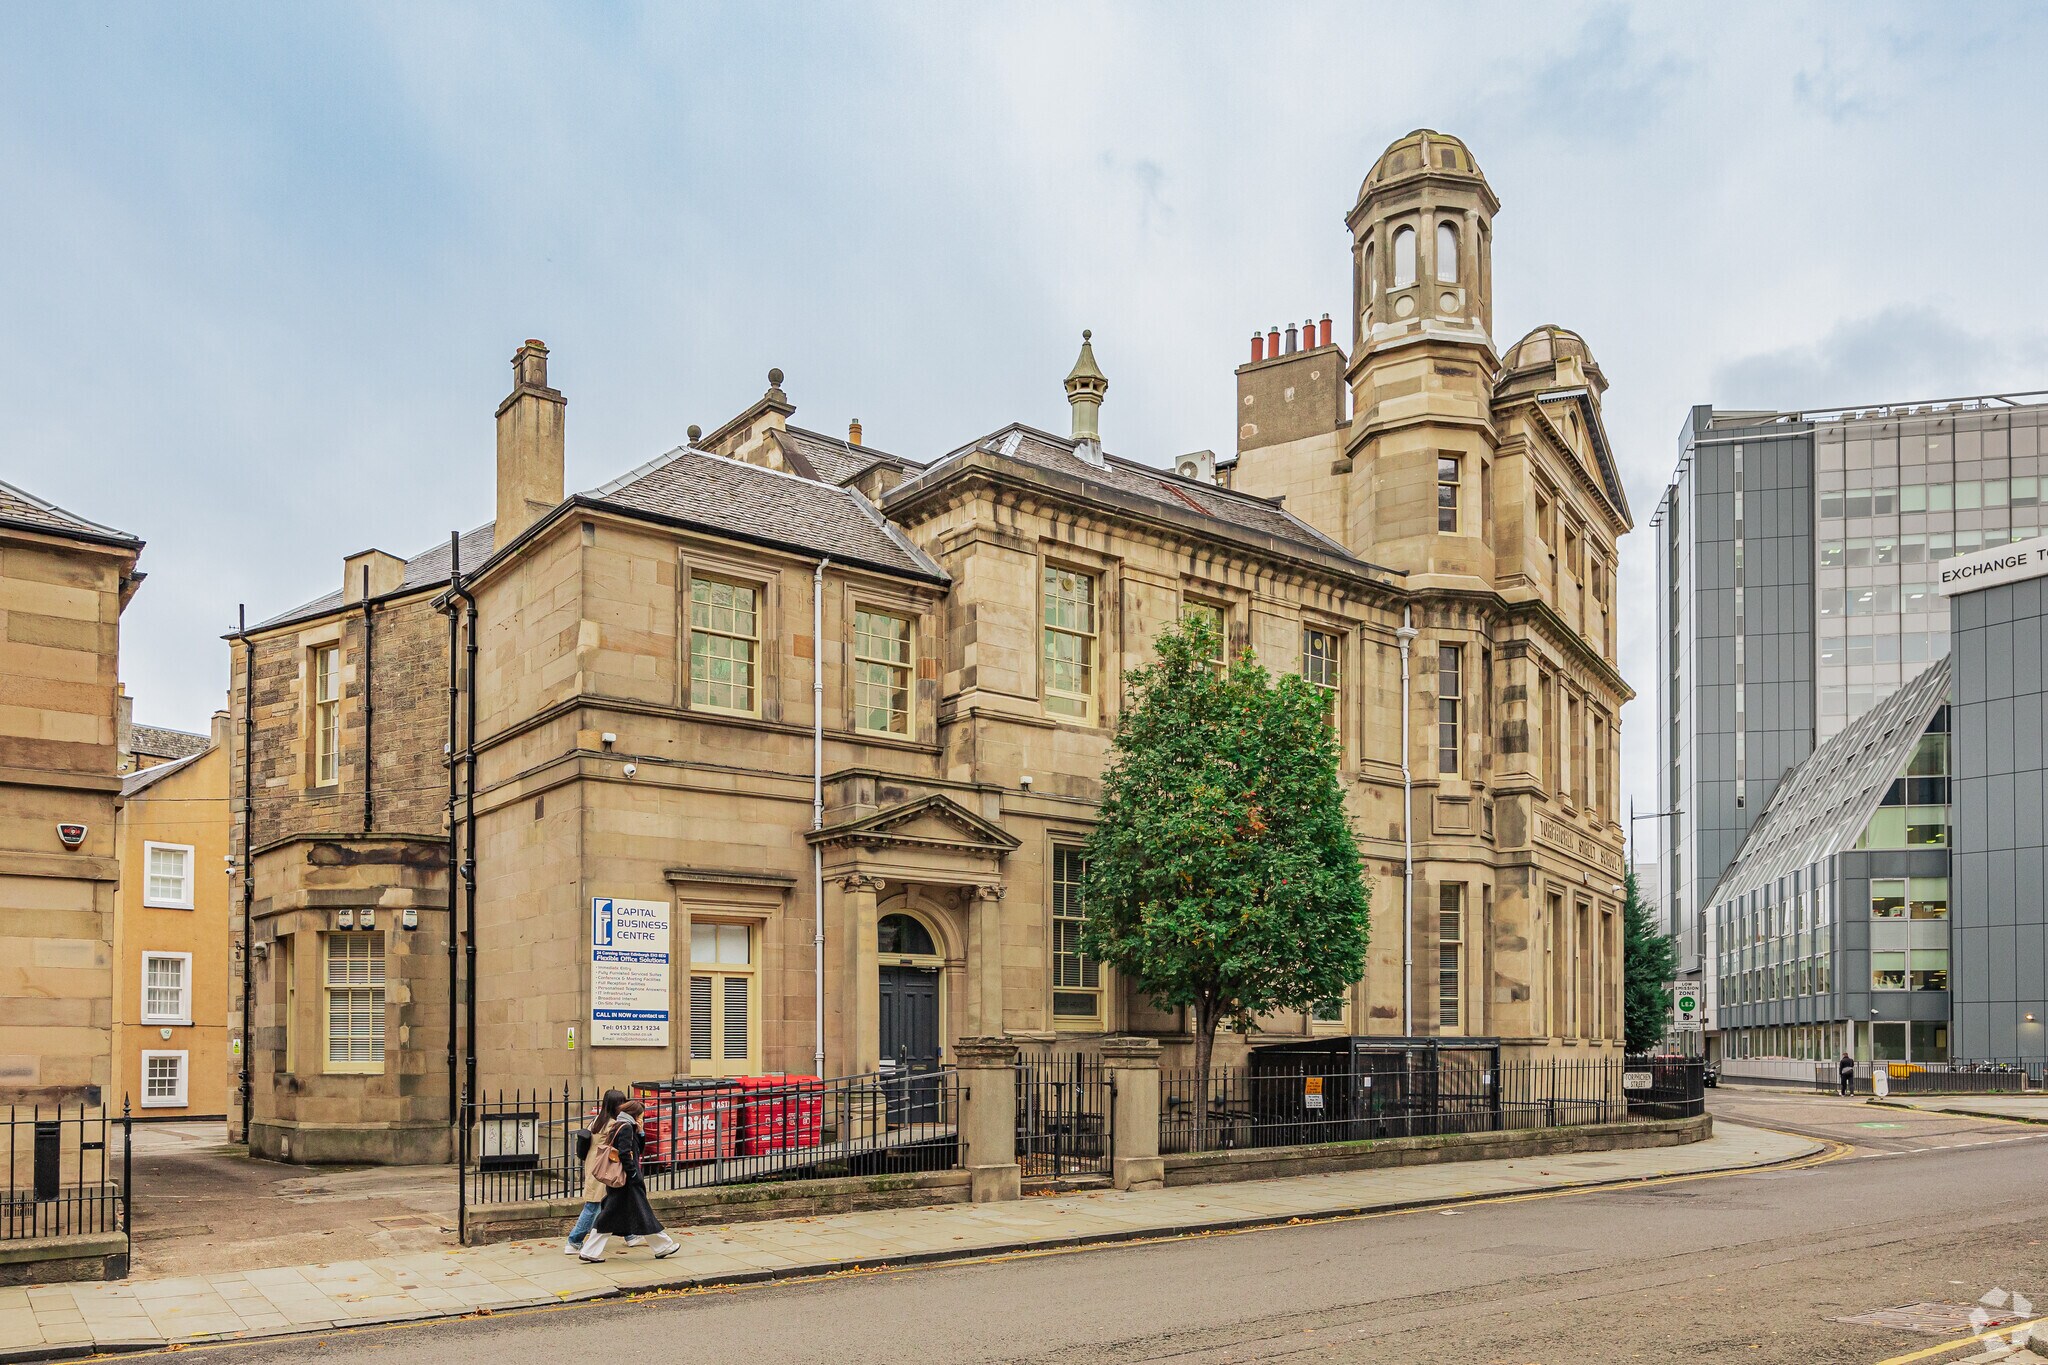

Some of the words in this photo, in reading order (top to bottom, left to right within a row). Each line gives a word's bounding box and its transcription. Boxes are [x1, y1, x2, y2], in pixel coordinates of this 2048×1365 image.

[1942, 553, 2027, 583] EXCHANGE
[2037, 548, 2048, 560] T
[1540, 820, 1574, 849] TORPHICHEN
[1578, 839, 1596, 860] STREET
[1600, 849, 1618, 871] SCHOOL
[617, 907, 656, 917] CAPITAL
[617, 919, 668, 930] BUSINESS
[617, 931, 655, 940] CENTRE
